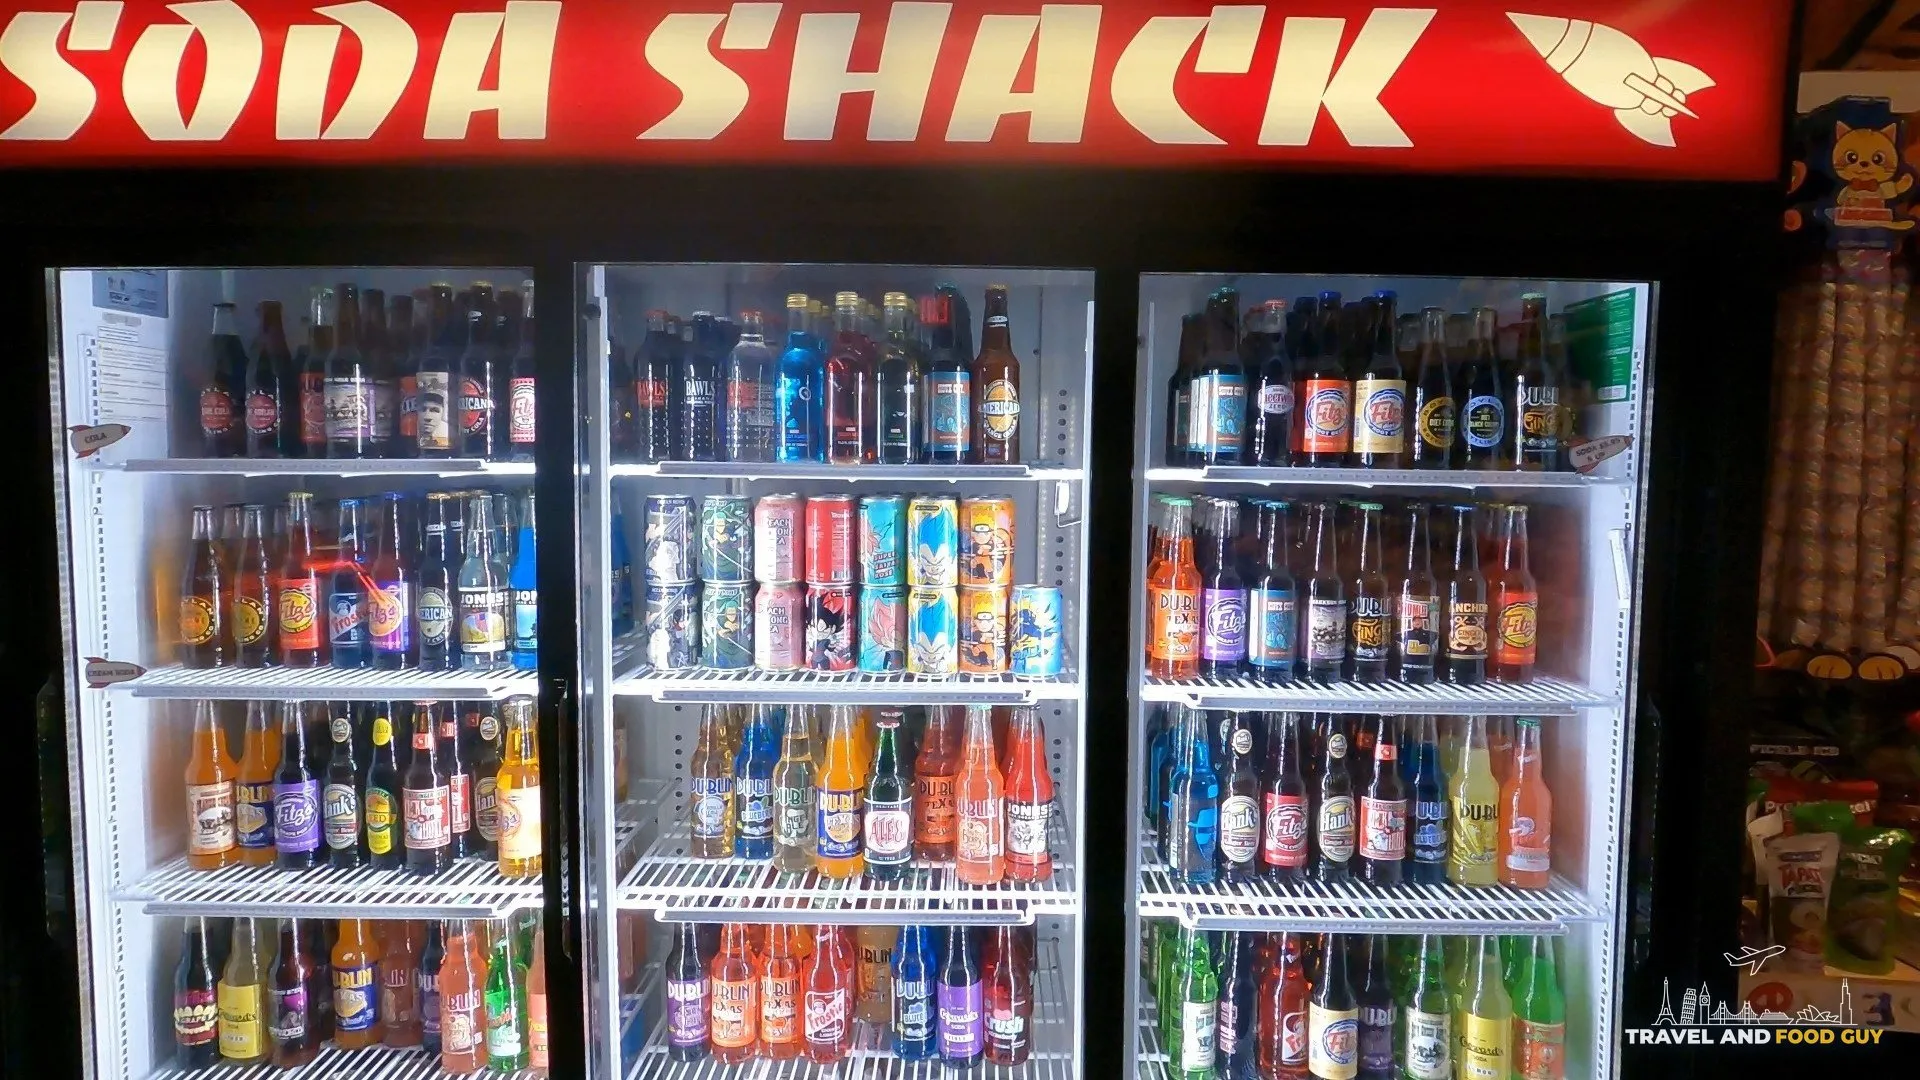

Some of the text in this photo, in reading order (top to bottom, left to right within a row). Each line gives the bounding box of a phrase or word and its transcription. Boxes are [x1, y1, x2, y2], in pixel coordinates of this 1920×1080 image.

[0, 0, 1438, 148] SODA SHACK
[685, 380, 715, 396] BAWLS
[84, 432, 108, 443] COLA
[1576, 445, 1598, 457] SODA
[767, 518, 790, 528] EACH
[1161, 593, 1199, 611] DUBL
[87, 669, 114, 677] CREAM
[736, 776, 772, 797] DUBL
[920, 780, 955, 798] DUBL
[277, 801, 315, 826] Fitz's
[1007, 803, 1048, 818] JONES
[1459, 802, 1499, 821] DUBL
[806, 1002, 844, 1032] Frostie
